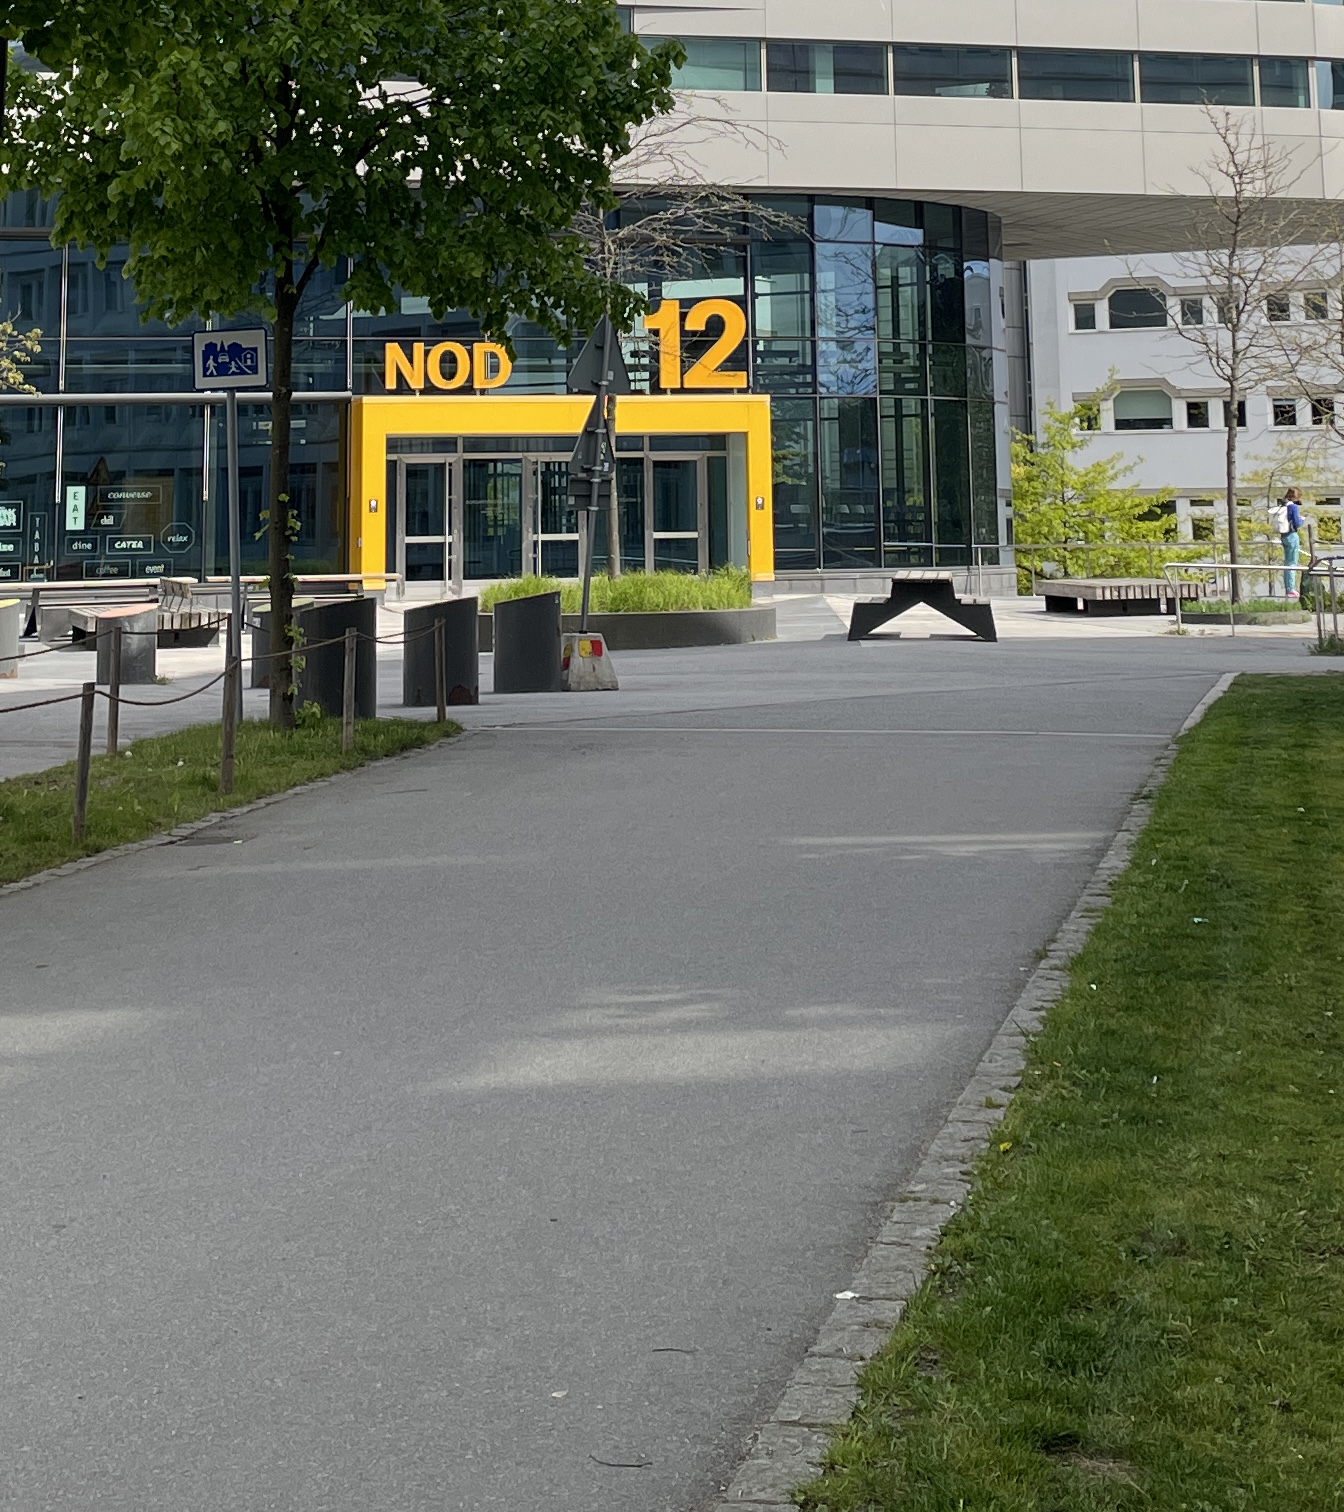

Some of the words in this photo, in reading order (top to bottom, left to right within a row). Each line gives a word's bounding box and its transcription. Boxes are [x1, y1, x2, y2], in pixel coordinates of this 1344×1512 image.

[384, 341, 513, 390] NOD
[643, 298, 748, 390] 12
[72, 541, 92, 550] dine
